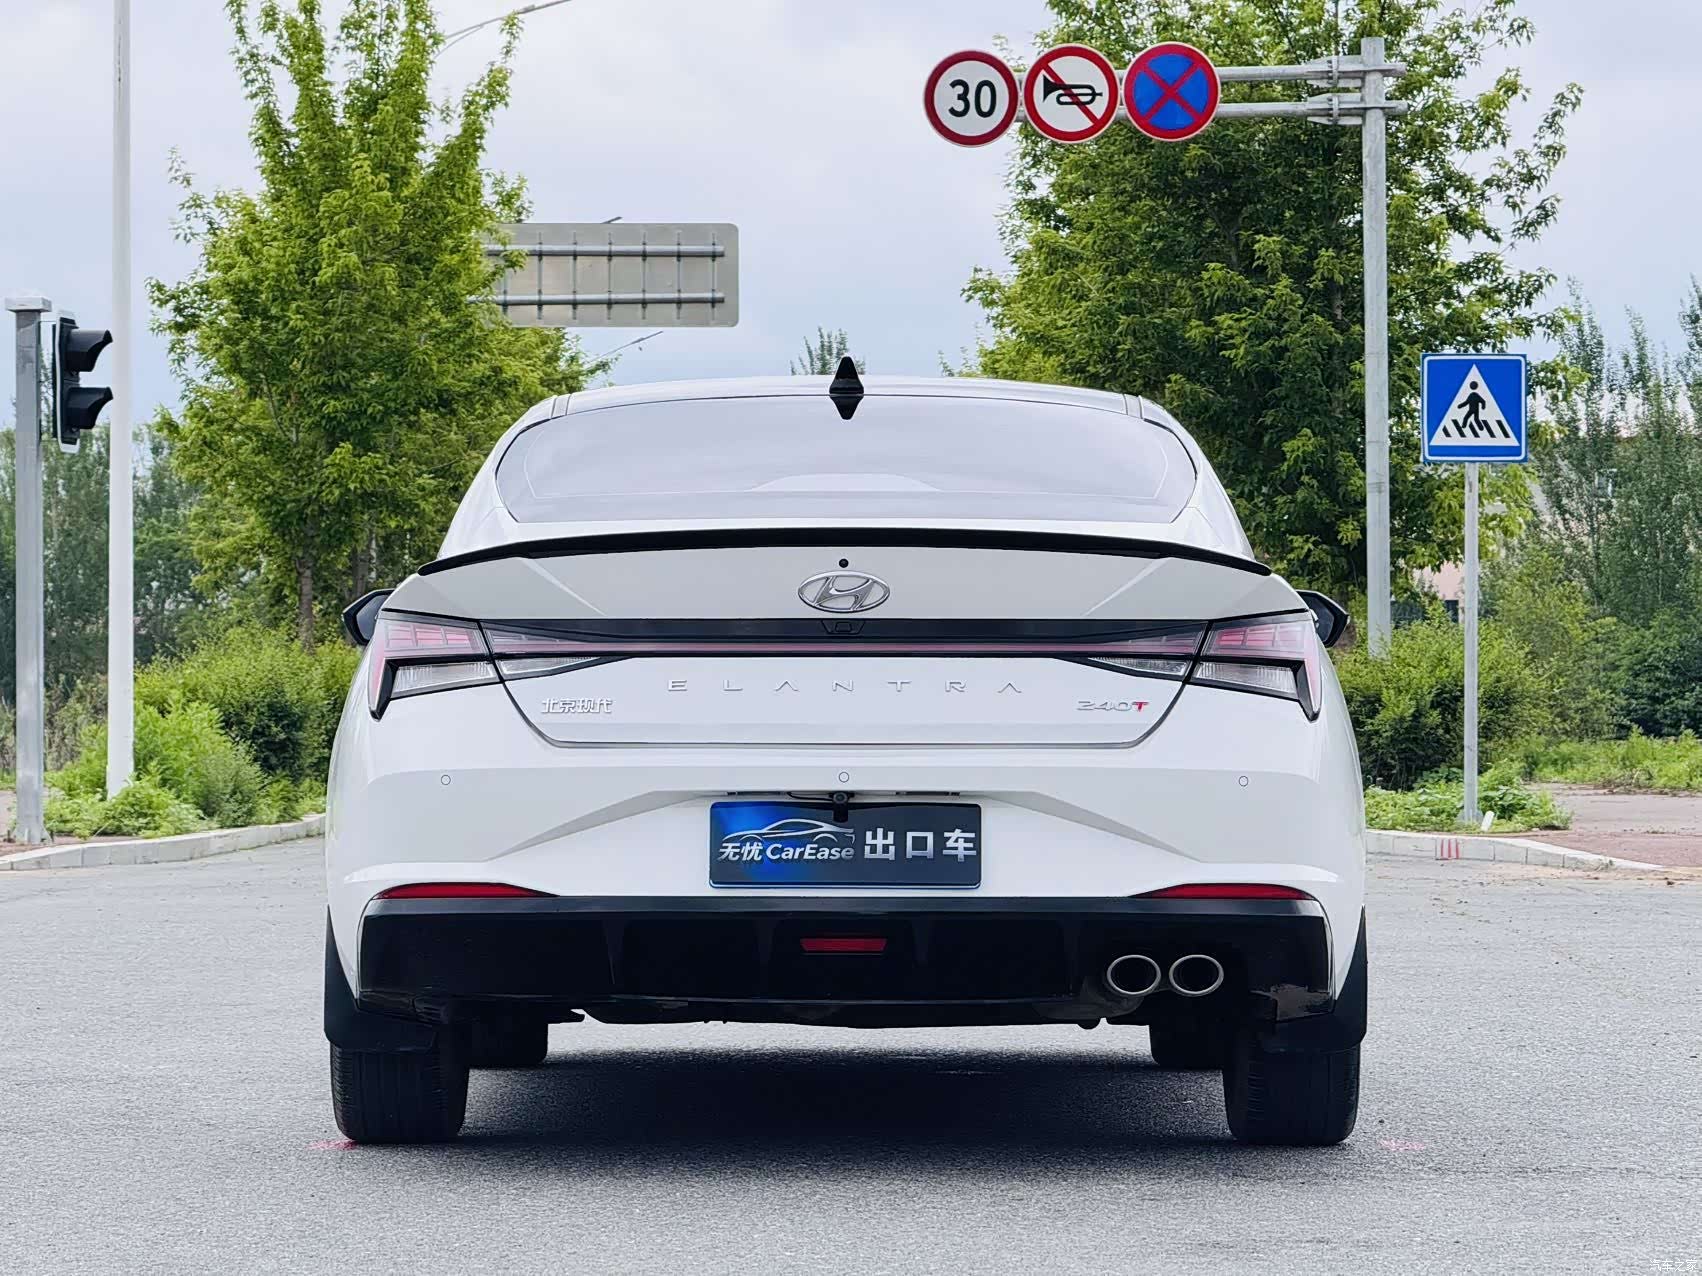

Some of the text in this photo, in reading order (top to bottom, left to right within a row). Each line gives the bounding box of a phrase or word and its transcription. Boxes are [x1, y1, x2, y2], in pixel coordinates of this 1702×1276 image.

[948, 79, 997, 118] 30
[668, 679, 1022, 693] ELANTRA
[541, 698, 613, 714] 北京现代
[1076, 701, 1149, 712] 240T
[718, 843, 855, 861] 无忧 CarEase
[863, 827, 977, 862] 出口车
